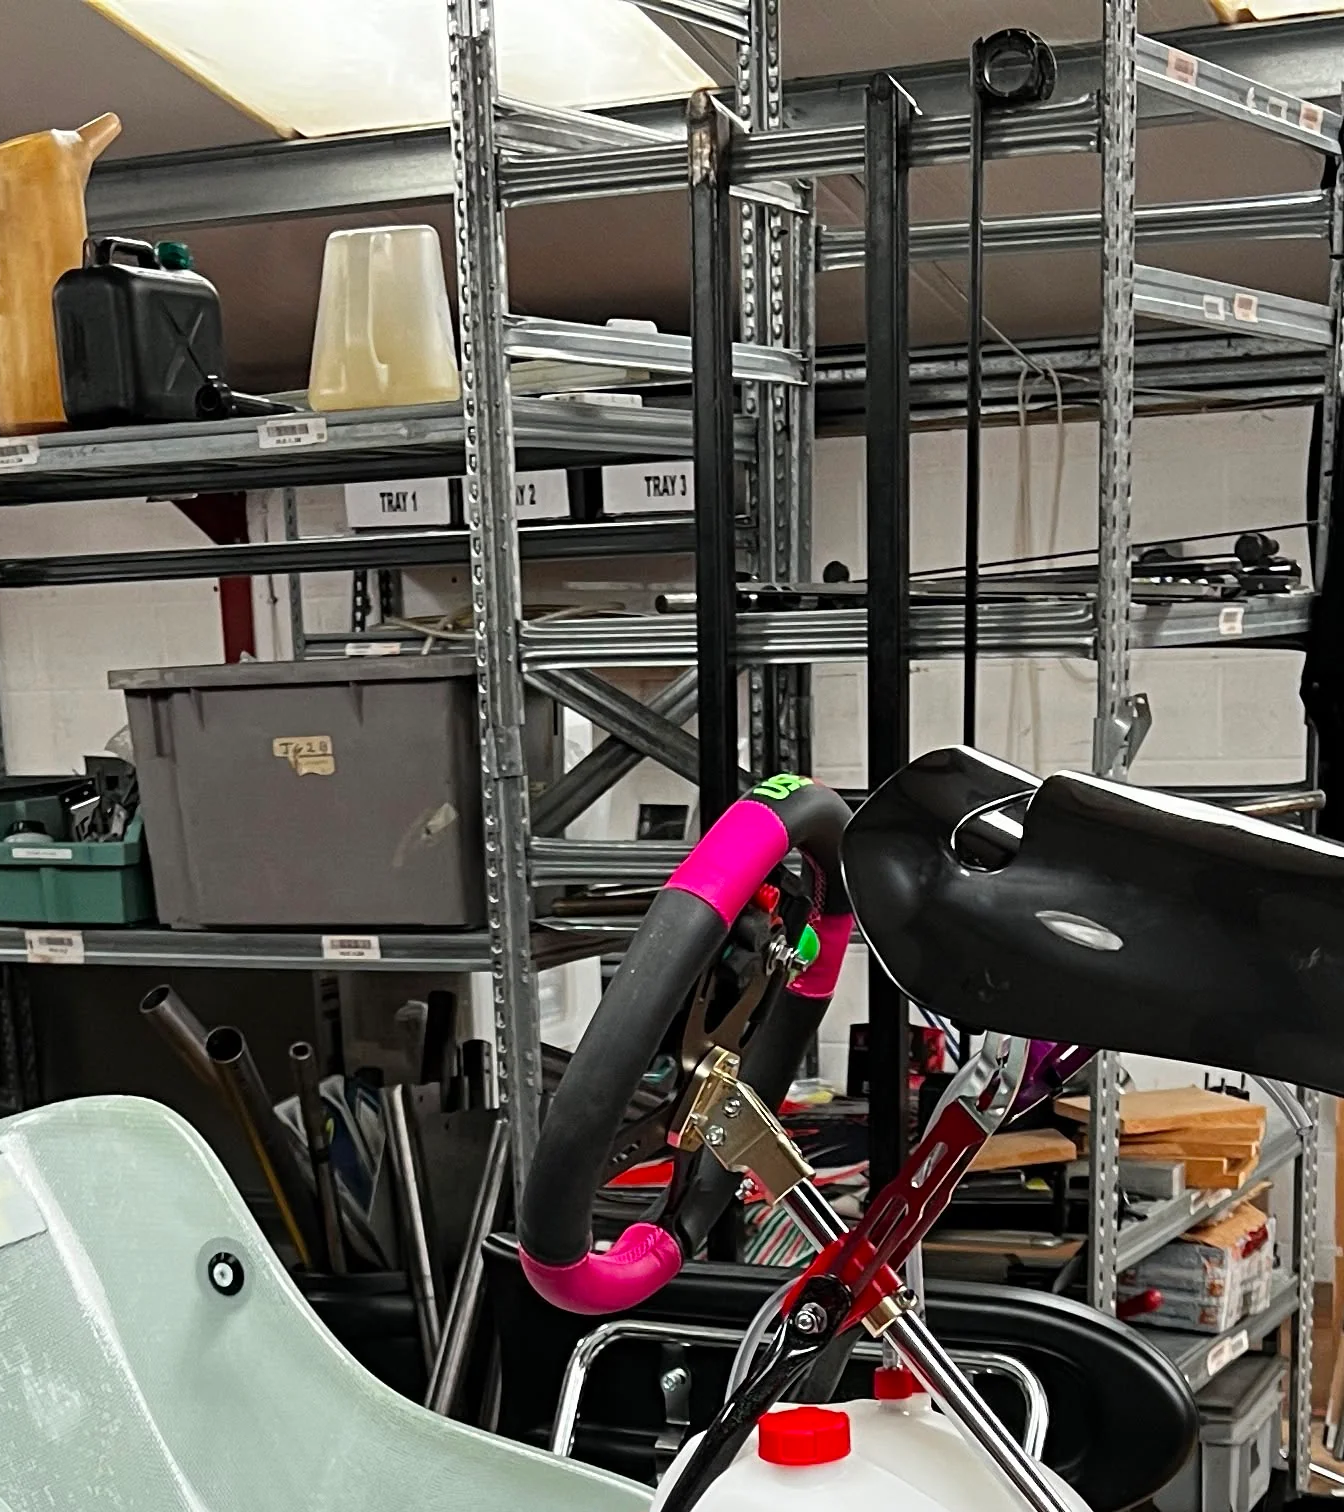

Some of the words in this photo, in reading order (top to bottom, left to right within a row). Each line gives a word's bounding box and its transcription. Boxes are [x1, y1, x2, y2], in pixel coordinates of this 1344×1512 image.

[529, 483, 537, 506] 2
[644, 475, 677, 498] TRAY
[680, 474, 688, 497] 3
[379, 491, 407, 513] TRAY
[411, 491, 417, 512] 1
